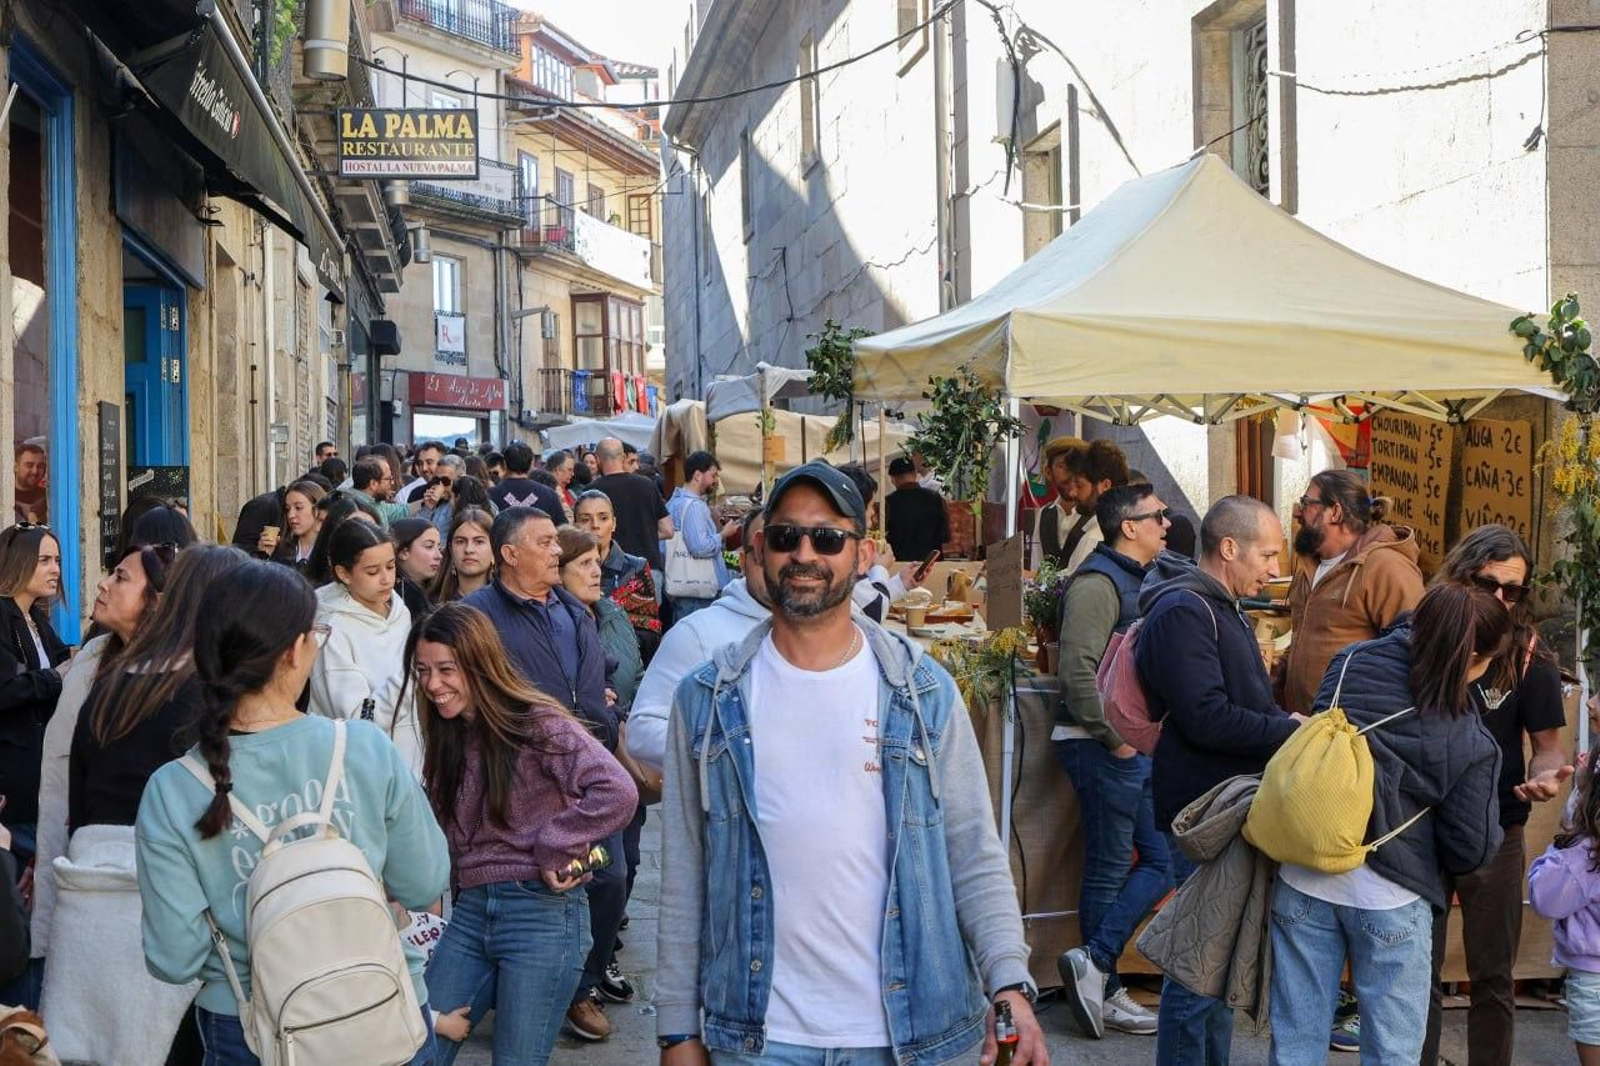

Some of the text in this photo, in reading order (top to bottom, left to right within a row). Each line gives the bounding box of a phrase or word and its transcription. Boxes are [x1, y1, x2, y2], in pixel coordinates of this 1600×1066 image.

[342, 112, 475, 140] LA PALMA
[342, 141, 475, 157] RESTAURANTE
[344, 160, 474, 174] HOSTAL LA NUEVA PALMA
[1371, 415, 1421, 442] CHOURIPAN
[1465, 426, 1493, 449] AUGA
[1371, 436, 1419, 466] TORTIPAN
[1371, 461, 1420, 495] EMPANADA
[1465, 460, 1500, 492] CAÑA
